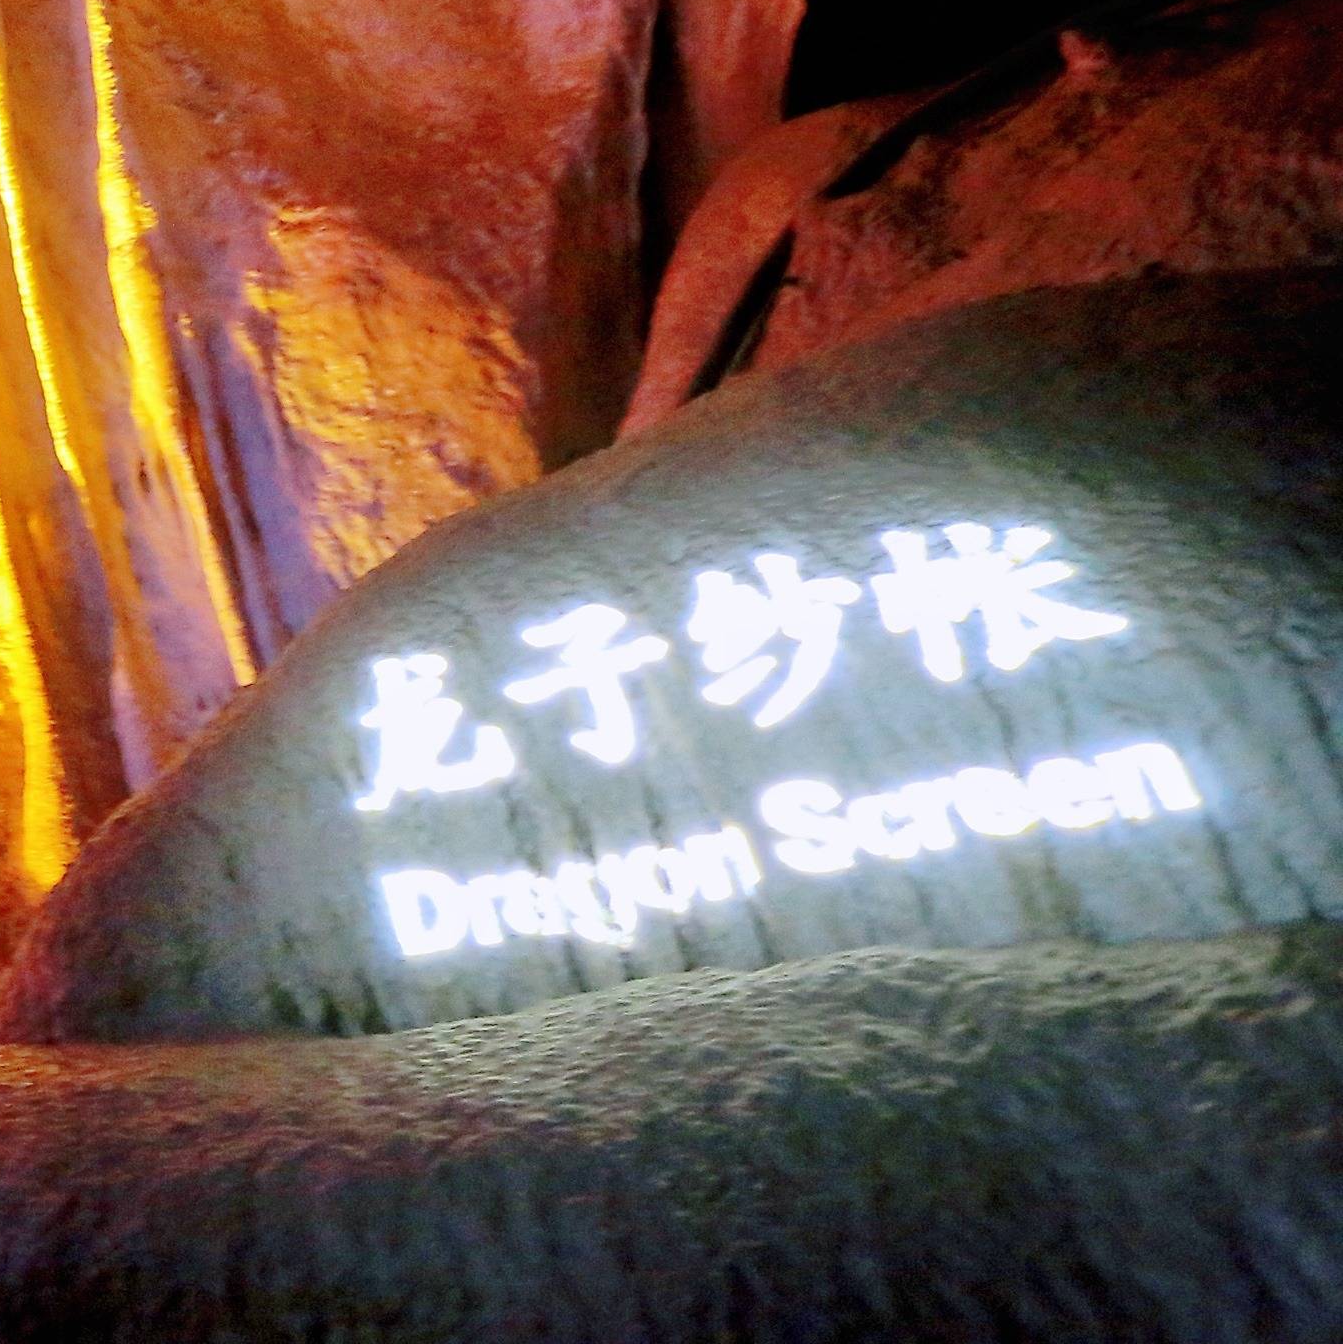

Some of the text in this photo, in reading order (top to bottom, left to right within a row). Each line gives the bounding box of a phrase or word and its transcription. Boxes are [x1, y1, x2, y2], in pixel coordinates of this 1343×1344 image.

[354, 522, 1129, 813] 龙子纱帐
[380, 742, 1202, 957] Dragon Screen
